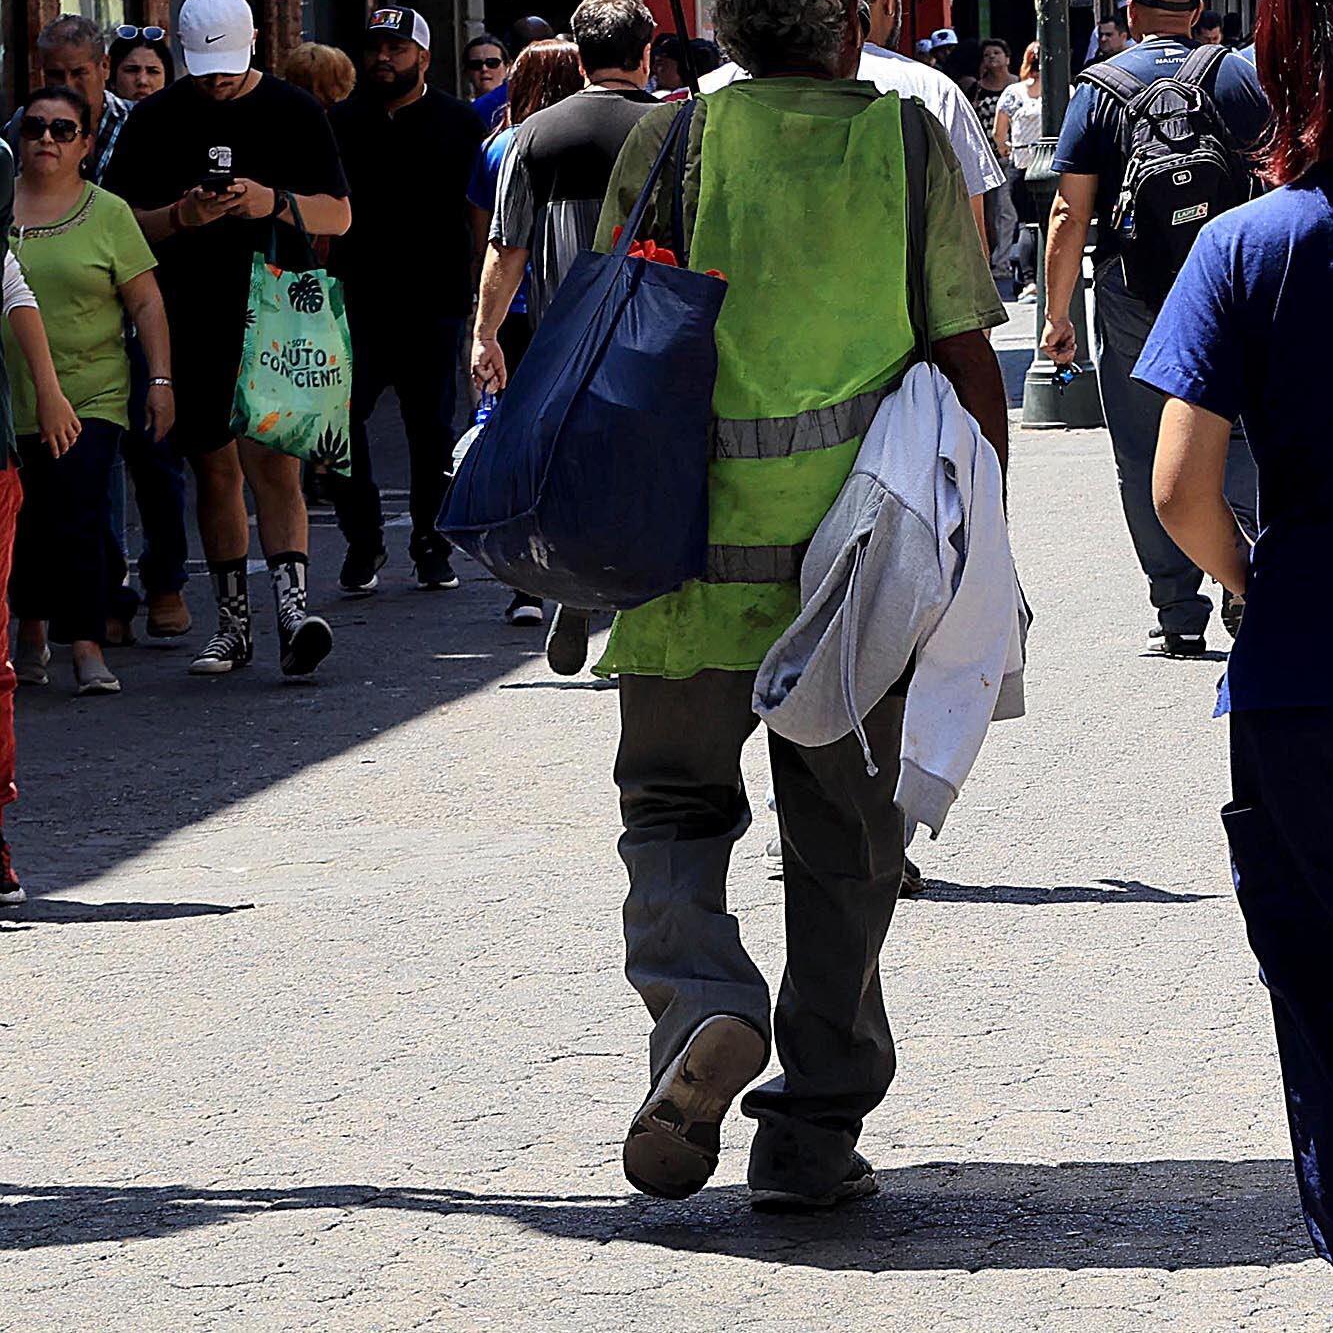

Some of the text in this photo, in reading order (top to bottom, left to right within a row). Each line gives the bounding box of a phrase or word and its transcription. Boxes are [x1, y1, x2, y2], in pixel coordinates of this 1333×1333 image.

[291, 338, 306, 348] SOY
[281, 348, 327, 369] AUTO
[260, 351, 343, 390] CONCIENTE
